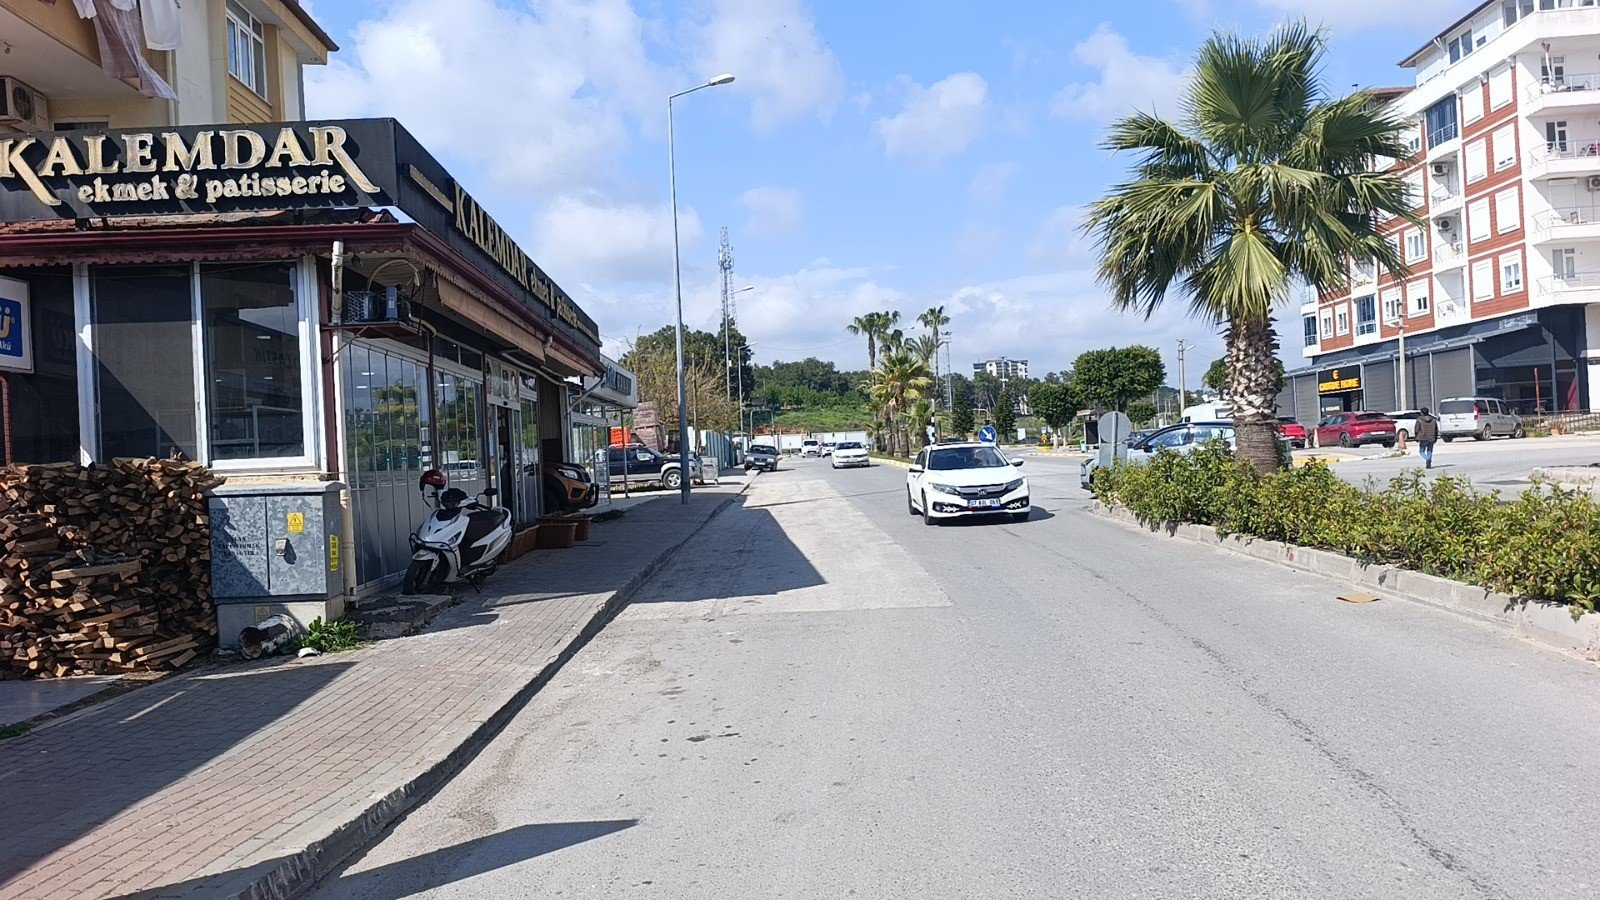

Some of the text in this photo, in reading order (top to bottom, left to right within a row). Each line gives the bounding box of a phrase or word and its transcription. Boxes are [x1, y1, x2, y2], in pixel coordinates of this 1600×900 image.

[0, 126, 380, 206] KALEMDAR
[78, 169, 346, 203] ekmek & patisserie
[454, 181, 529, 290] KALEMDAR
